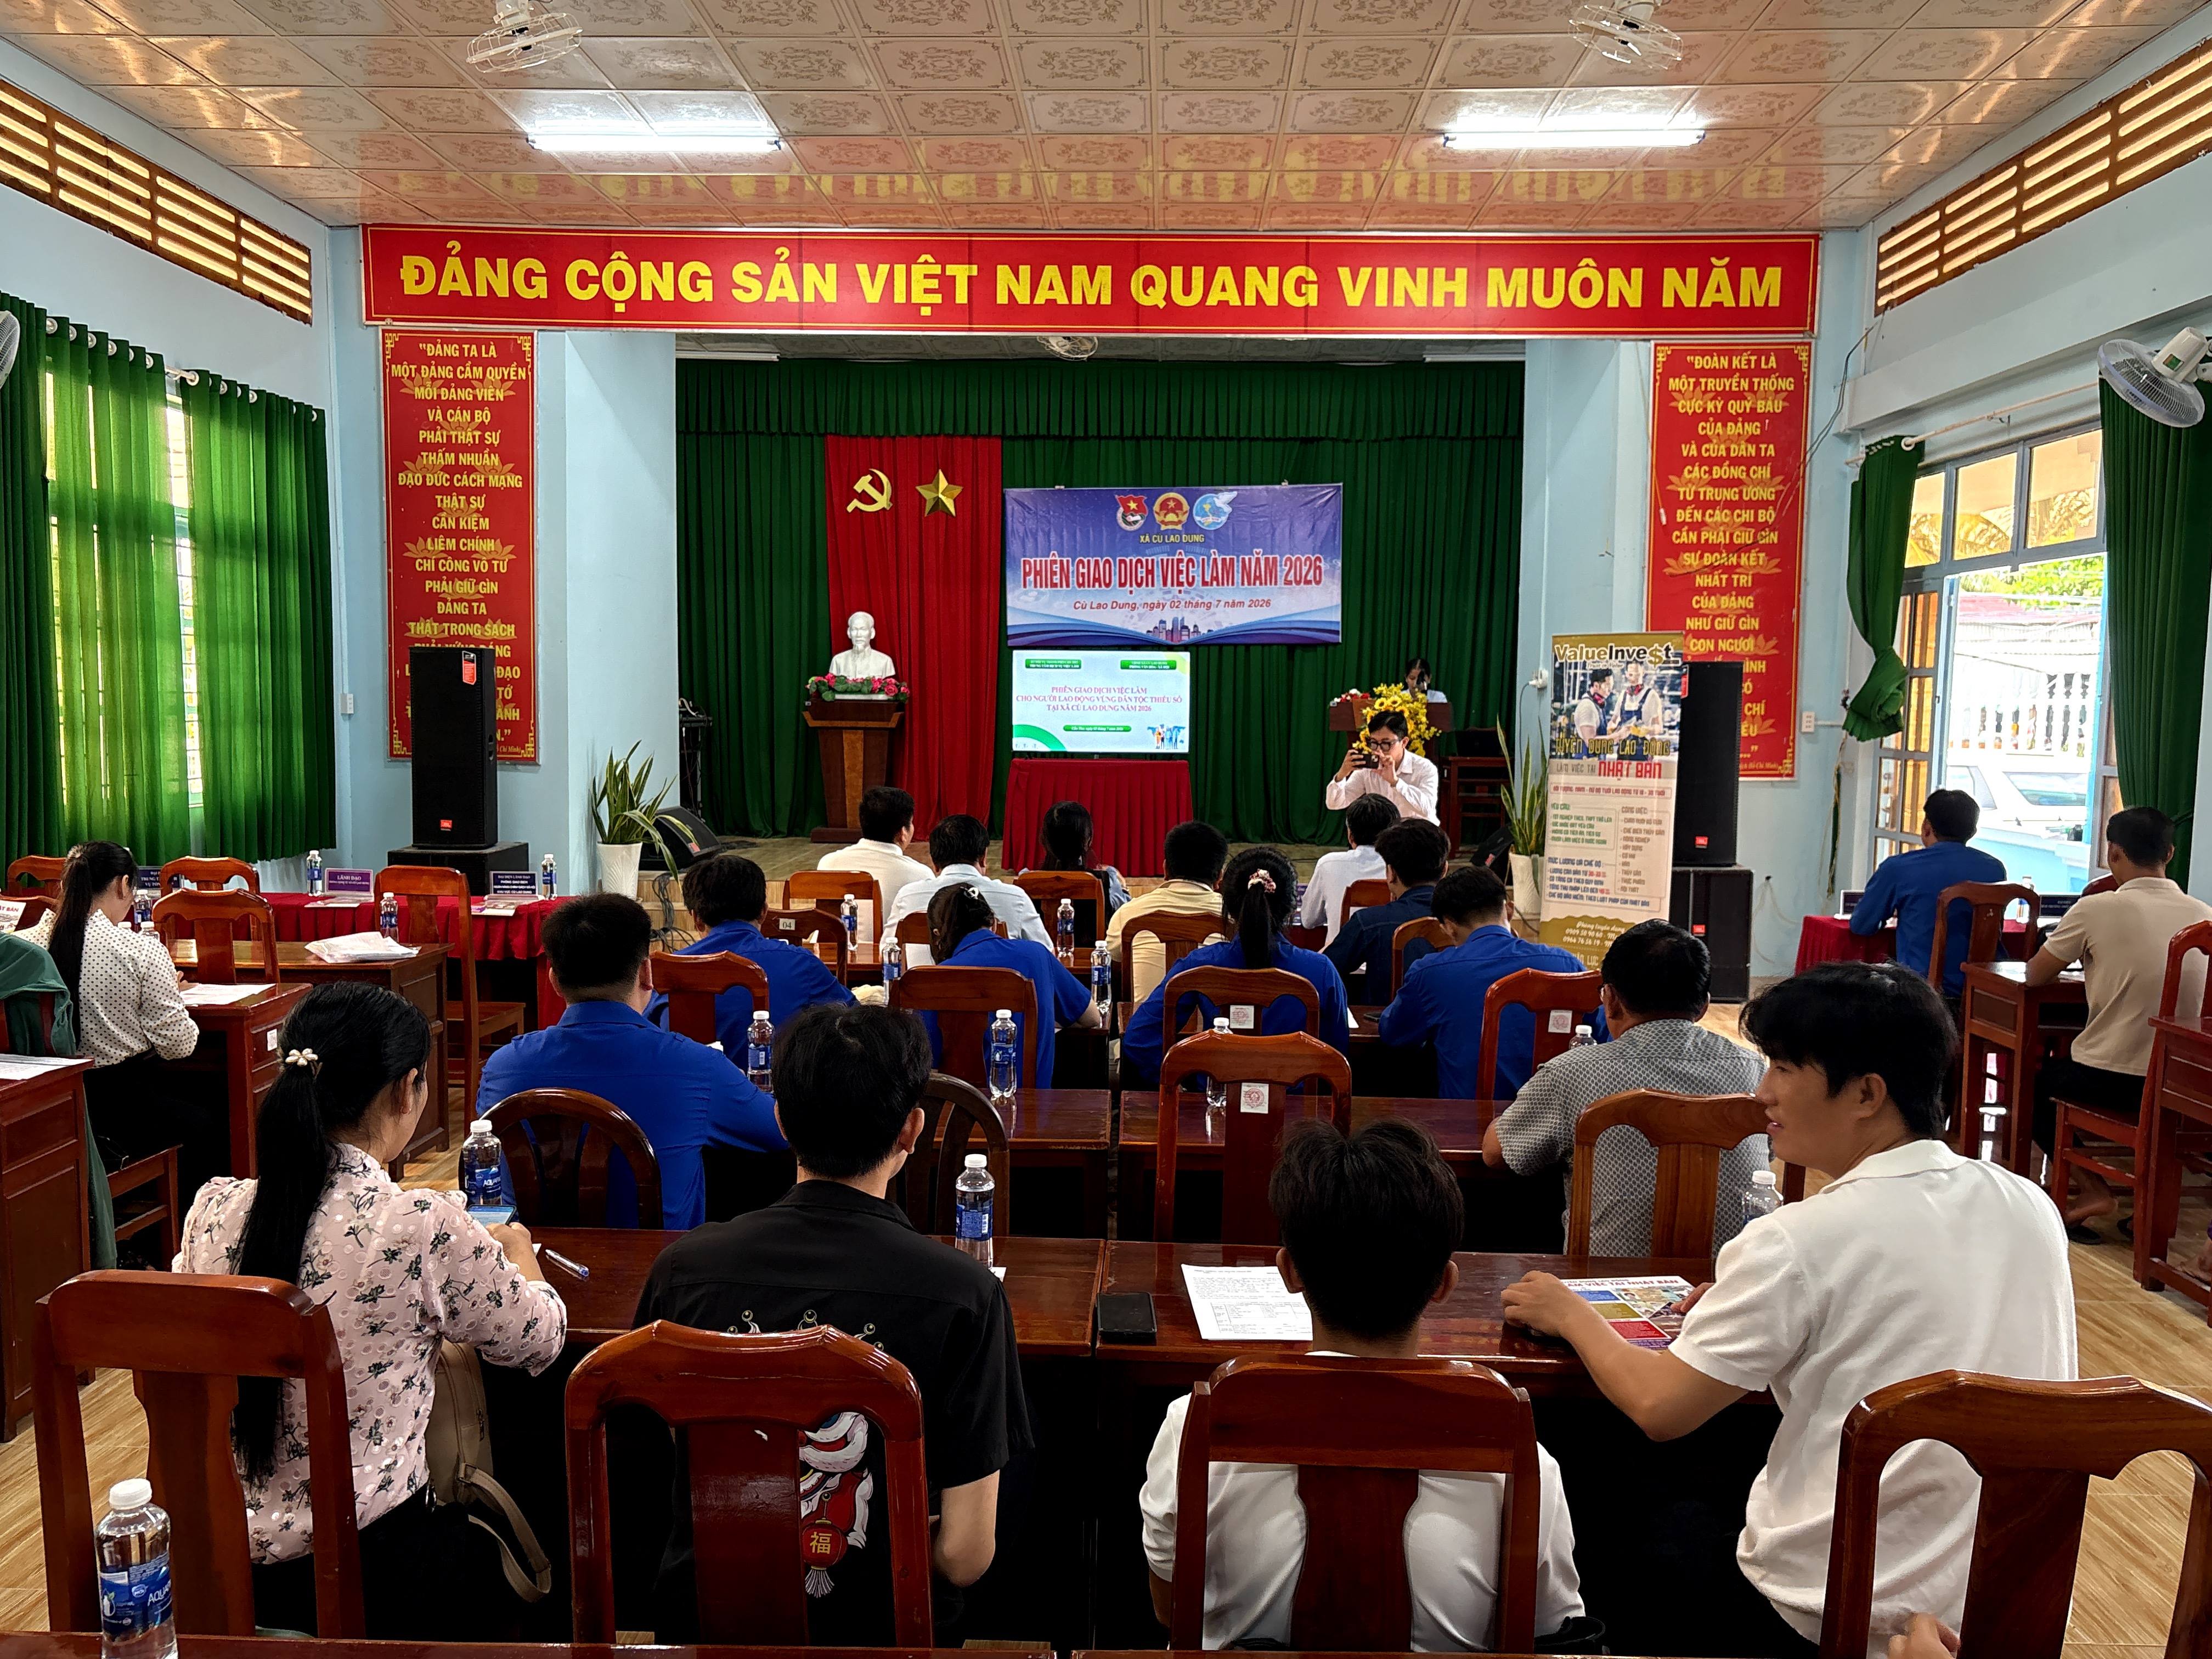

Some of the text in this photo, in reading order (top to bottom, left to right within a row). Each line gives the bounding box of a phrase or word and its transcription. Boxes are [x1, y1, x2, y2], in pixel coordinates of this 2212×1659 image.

[401, 241, 1782, 316] ĐẢNG CỘNG SẢN VIỆT NAM QUANG VINH MUÔN NĂM
[463, 345, 477, 357] TA
[482, 342, 497, 358] LÀ
[1732, 351, 1776, 369] KẾT LÀ
[392, 361, 526, 381] MỘT ĐẢNG CẦM QUYỀN
[415, 381, 504, 402] MỖI ĐẢNG VIÊN
[1668, 373, 1795, 394] MỘT TRUYỀN THỐNG
[427, 406, 491, 425] VÀ CÁN BỘ
[1678, 397, 1782, 416] CỰC KỲ QUÝ BÁU
[1698, 416, 1760, 435] CỦA ĐẢNG
[419, 427, 501, 447] PHẢI THẬT SỰ
[421, 448, 499, 466] THẤM NHUẦN
[1681, 439, 1775, 457] VÀ CỦA DÂN TA
[1684, 460, 1771, 479] CÁC ĐỒNG CHÍ
[399, 471, 523, 490] ĐẠO ĐỨC CÁCH MẠNG
[436, 493, 486, 511] THẬT SỰ
[1678, 485, 1775, 501] TỪ TRUNG ƯƠNG
[432, 513, 489, 532] CẦN KIỆM
[1676, 504, 1775, 525] ĐẾN CÁC CHI BỘ
[427, 534, 495, 552] LIÊM CHÍNH
[1139, 533, 1205, 543] XÃ CÙ LAO DUNG
[1672, 526, 1778, 544] CẦN PHẢI GIỮ GÌN
[415, 556, 509, 573] CHÍ CÔNG VÔ TƯ
[1683, 548, 1765, 568] SỰ ĐOÀN KẾT
[1022, 549, 1323, 595] PHIÊN GIAO DỊCH VIỆC LÀM NĂM 2026
[1695, 572, 1752, 588] NHẤT TRÍ
[425, 576, 498, 594] PHẢI GIỮ GÌN
[437, 597, 487, 615] ĐẢNG TA
[1074, 599, 1271, 612] Cù Lao Dung, ngày 02 tháng 7 năm 2026
[1692, 591, 1754, 609] CỦA ĐẢNG
[1686, 613, 1759, 630] NHƯ GIỮ GÌN
[410, 622, 515, 640] THẬT TRONG SẠCH
[1690, 635, 1754, 652] CON NGƯỜI
[497, 666, 521, 681] ĐẠO
[497, 686, 513, 699] TỚ
[1113, 686, 1130, 695] VIỆC
[1074, 696, 1095, 704] ĐỘNG
[1745, 700, 1767, 715] CHÍ
[809, 1531, 832, 1554] 福
